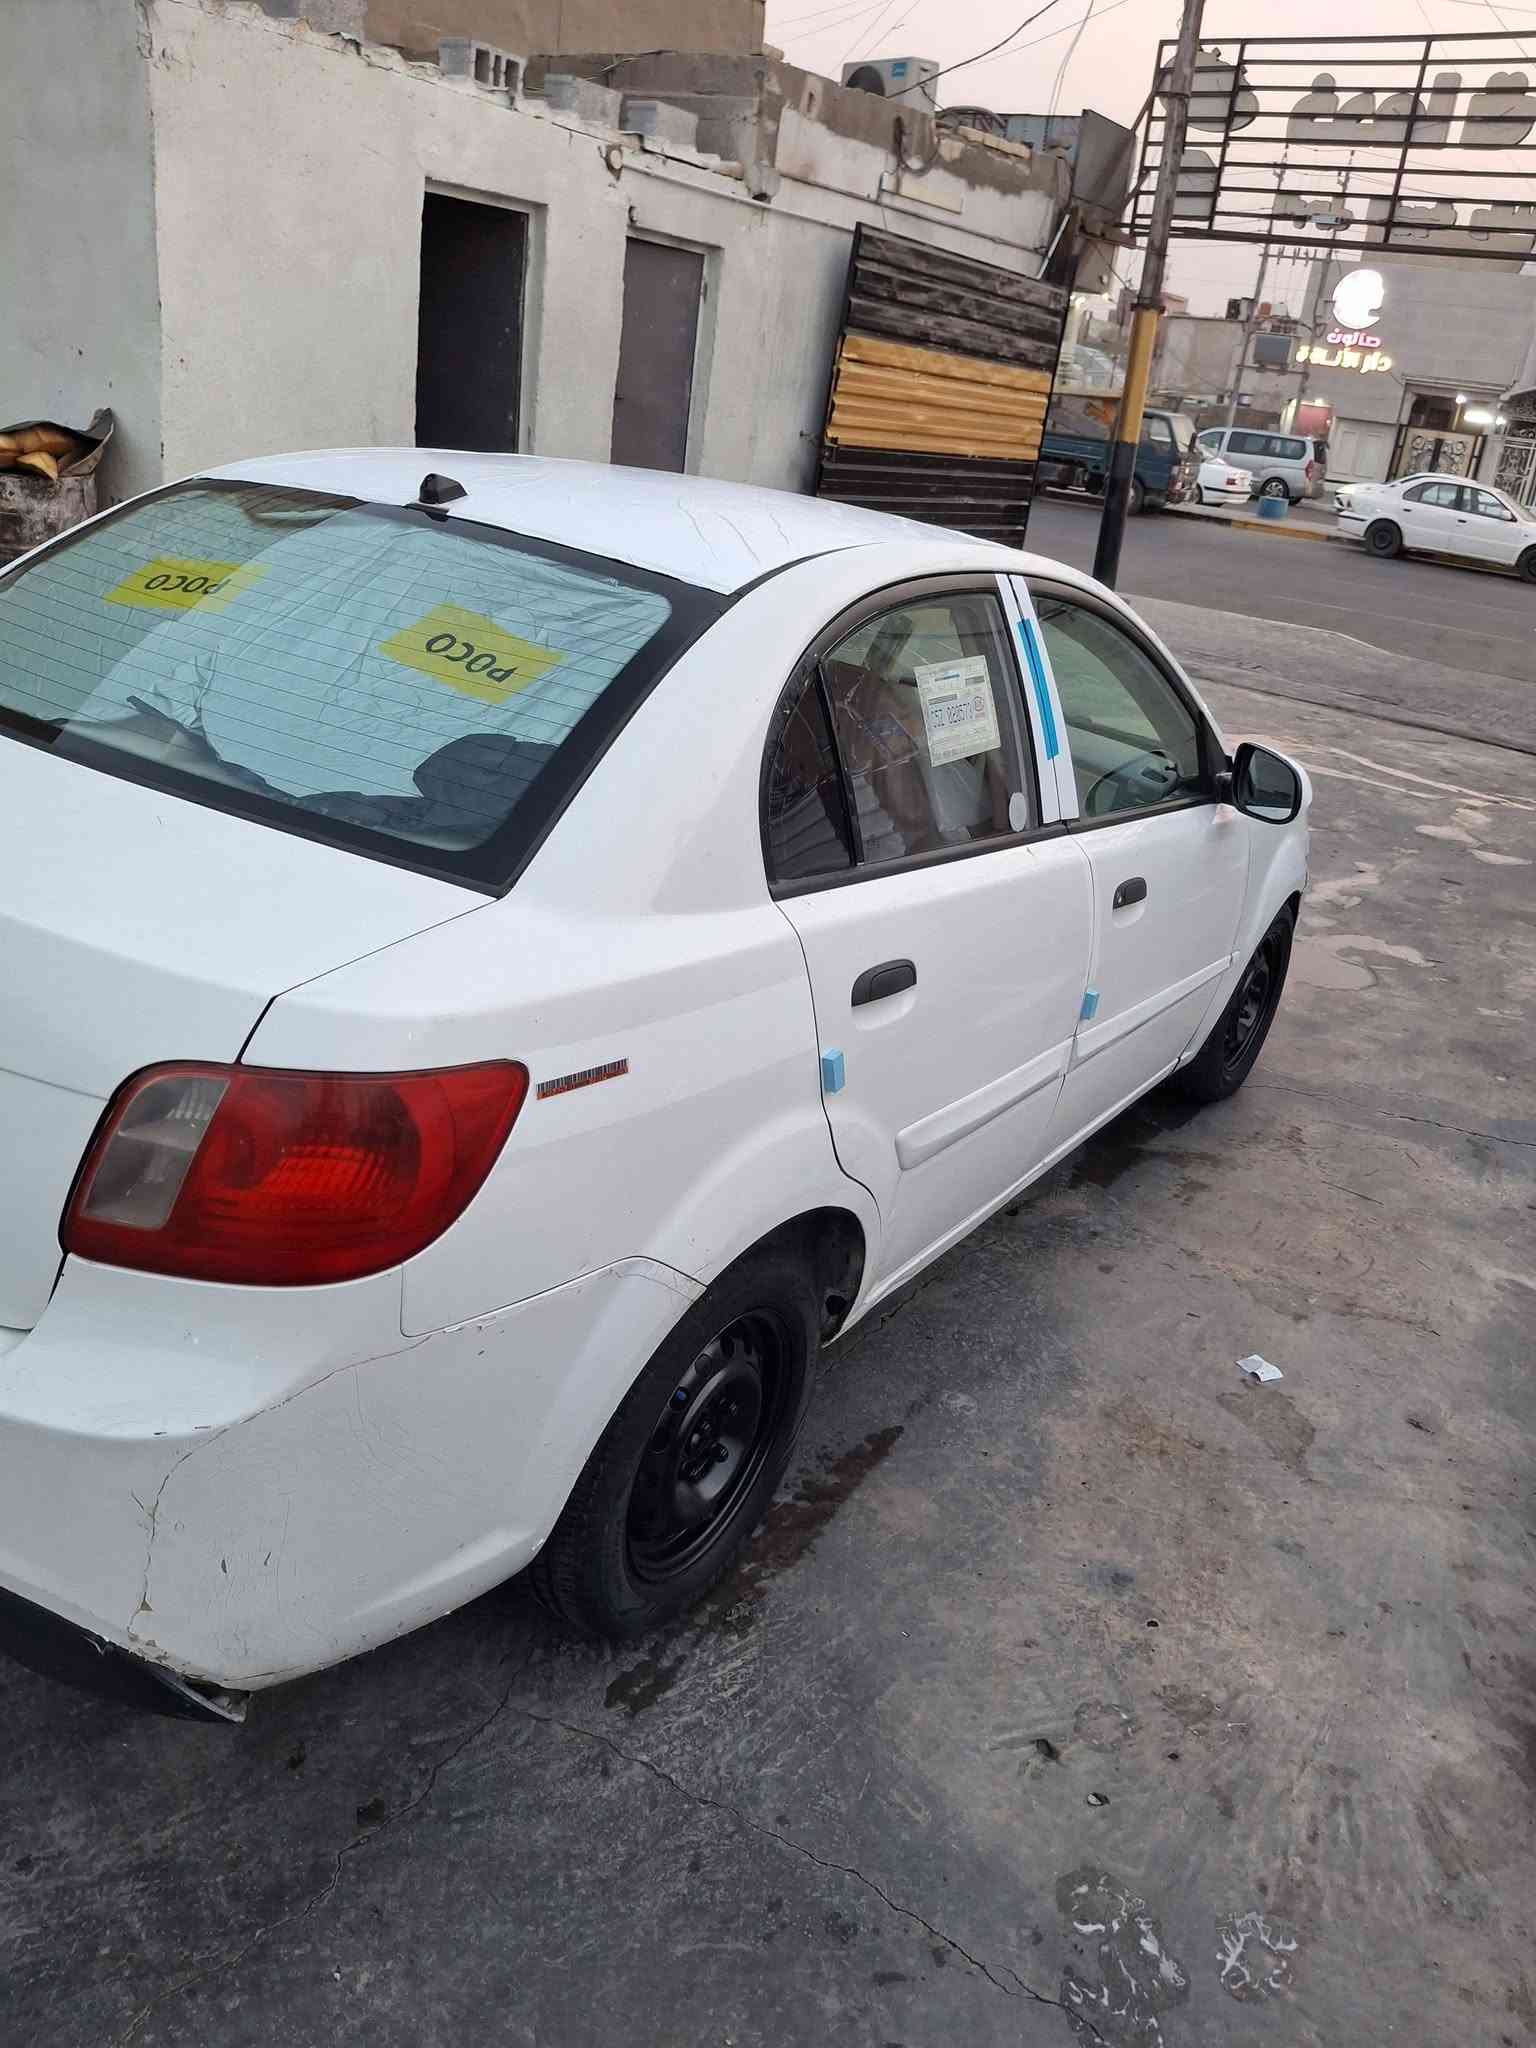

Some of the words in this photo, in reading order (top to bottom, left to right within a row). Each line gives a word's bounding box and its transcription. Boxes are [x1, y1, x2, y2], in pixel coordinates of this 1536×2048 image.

[1327, 328, 1380, 347] صالون
[144, 574, 232, 595] POCO
[425, 633, 518, 683] POCO
